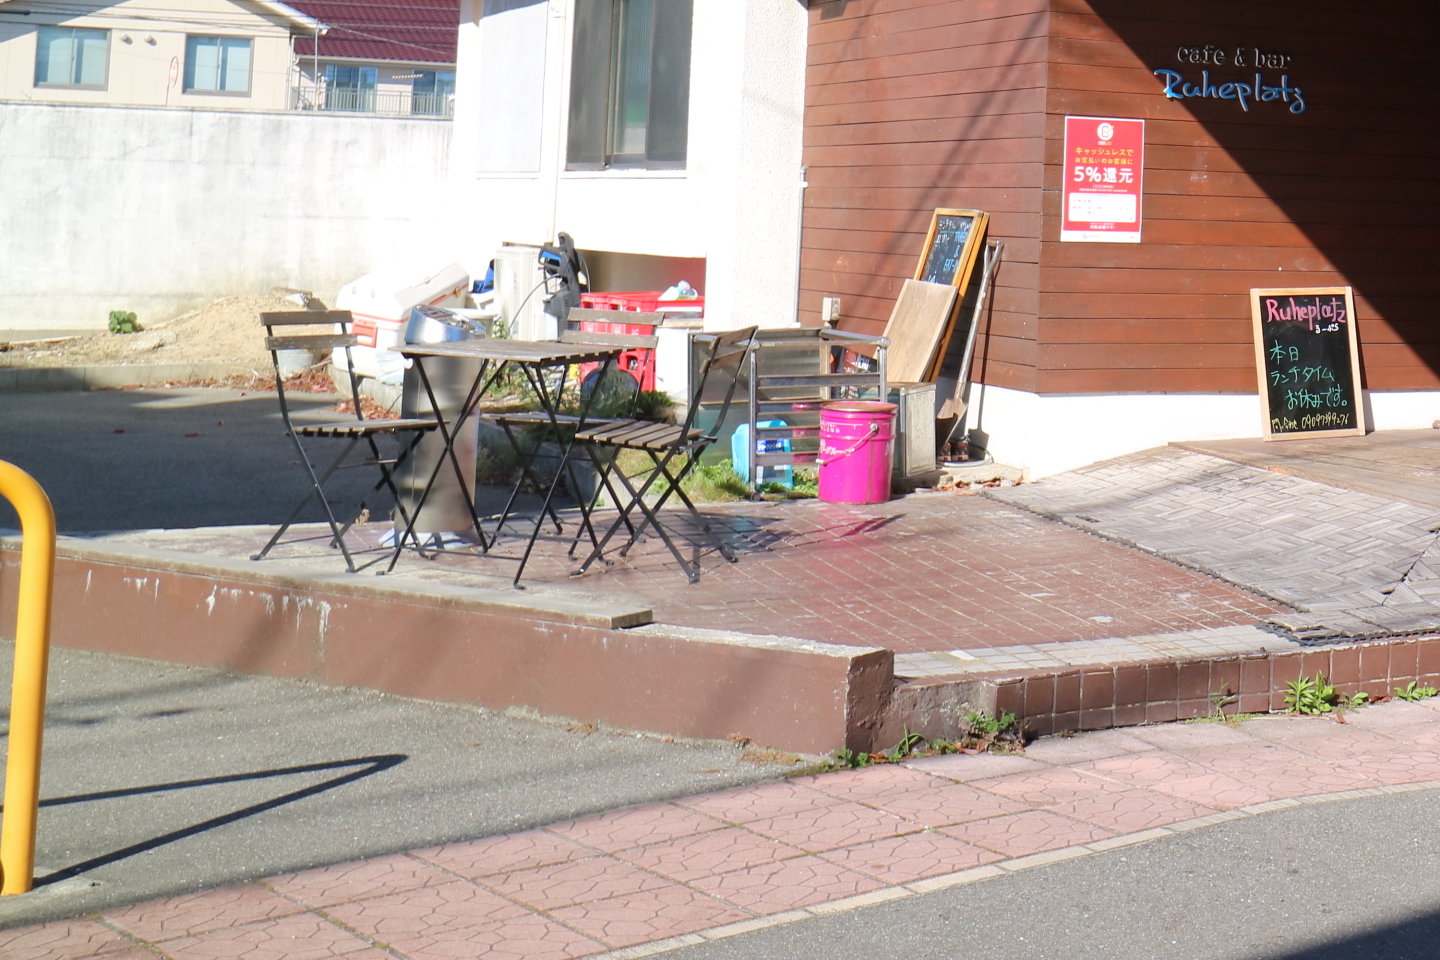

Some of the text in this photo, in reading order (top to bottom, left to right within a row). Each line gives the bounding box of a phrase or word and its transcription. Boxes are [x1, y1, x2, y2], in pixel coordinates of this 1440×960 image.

[1177, 44, 1291, 69] cafe & bar
[1154, 68, 1306, 114] Ruheplatz
[1075, 147, 1134, 157] キャッシュレスで
[1075, 157, 1133, 165] お支払いのお客様に
[1073, 166, 1134, 184] 5%還元
[1266, 297, 1346, 331] Ruheplatz
[1270, 340, 1299, 364] 本日
[1271, 366, 1335, 386] ランチタイム
[1285, 384, 1347, 410] お休みです。
